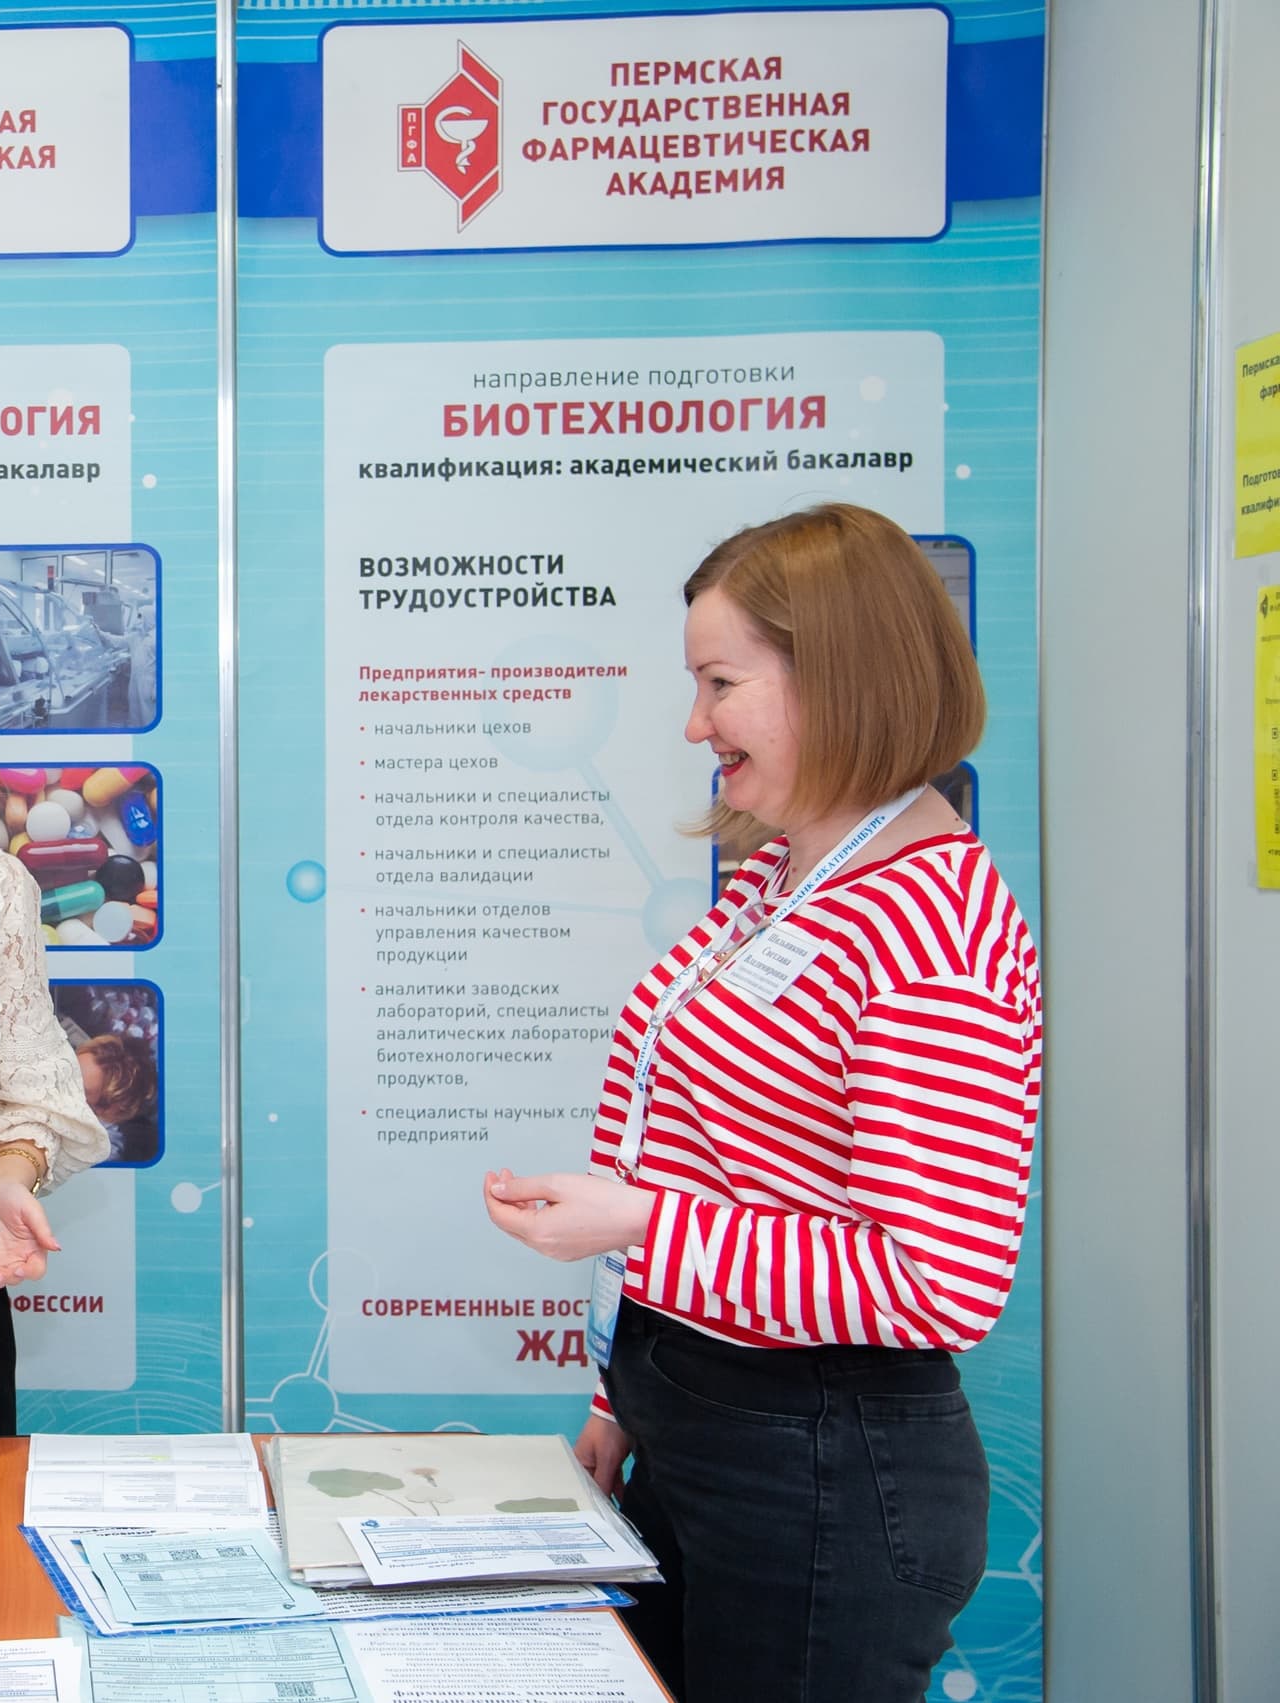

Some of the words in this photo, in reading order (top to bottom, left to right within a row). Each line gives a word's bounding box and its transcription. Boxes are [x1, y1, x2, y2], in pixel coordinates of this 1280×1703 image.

[610, 56, 782, 87] ПЕРМСКАЯ
[542, 91, 850, 128] ГОСУДАРСТВЕННАЯ
[406, 111, 419, 165] ПГФА
[521, 128, 870, 164] ФАРМАЦЕВТИЧЕСКАЯ
[605, 165, 785, 200] АКАДЕМИЯ
[473, 370, 640, 394] направление
[648, 365, 795, 390] подготовки
[443, 394, 826, 438] БИОТЕХНОЛОГИЯ
[359, 457, 562, 483] квалификация:
[569, 450, 778, 478] академический
[787, 449, 913, 473] бакалавр
[359, 554, 564, 578] ВОЗМОЖНОСТИ
[358, 581, 617, 613] ТРУДОУСТРОЙСТВА
[359, 665, 486, 684] Предприятия-
[490, 665, 628, 681] производители
[358, 689, 498, 705] лекарственных
[502, 688, 572, 704] средств
[374, 723, 477, 736] начальники
[482, 722, 532, 737] цехов
[374, 757, 443, 773] мастера
[448, 757, 499, 772] цехов
[374, 791, 477, 804] начальники
[482, 791, 493, 803] и
[497, 790, 611, 805] специалисты
[375, 814, 434, 829] отдела
[439, 813, 518, 830] контроля
[523, 812, 604, 826] качества,
[375, 848, 477, 861] начальники
[482, 848, 493, 860] и
[497, 847, 611, 862] специалисты
[375, 871, 434, 886] отдела
[439, 871, 534, 885] валидации
[375, 905, 477, 918] начальники
[482, 904, 551, 919] отделов
[375, 927, 477, 944] управления
[482, 927, 571, 939] качеством
[376, 950, 468, 966] продукции
[375, 984, 466, 996] аналитики
[471, 983, 560, 998] заводских
[375, 1002, 491, 1022] лабораторий,
[496, 1005, 609, 1020] специалисты
[376, 1028, 506, 1041] аналитических
[376, 1047, 553, 1063] биотехнологических
[377, 1073, 469, 1089] продуктов,
[375, 1107, 488, 1122] специалисты
[493, 1107, 565, 1123] научных
[377, 1127, 489, 1145] предприятий
[9, 1295, 104, 1313] ФЕССИИ
[361, 1298, 536, 1317] СОВРЕМЕННЫЕ
